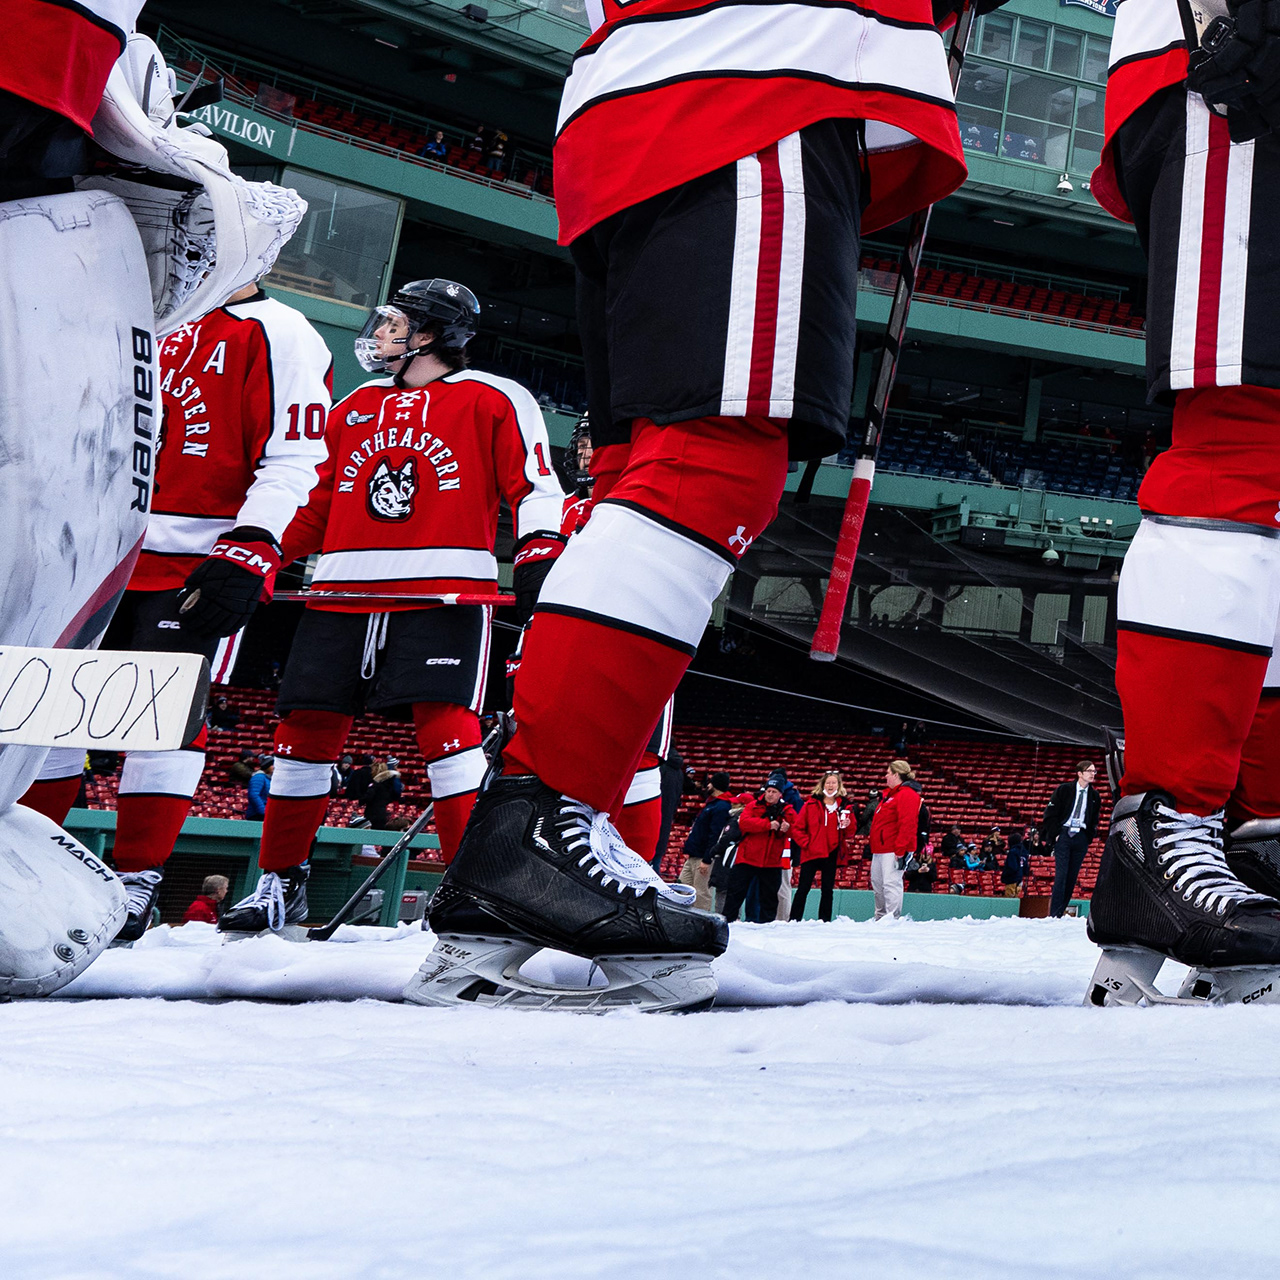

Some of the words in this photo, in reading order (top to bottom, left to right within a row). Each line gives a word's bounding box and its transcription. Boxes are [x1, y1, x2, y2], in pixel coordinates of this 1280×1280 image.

[187, 103, 276, 149] AVILION
[202, 340, 227, 375] A
[400, 348, 421, 360] CCM
[131, 326, 153, 515] BAUER
[285, 402, 326, 441] 10
[338, 427, 461, 493] NORTHEASTERN
[208, 543, 273, 575] CCM
[425, 657, 461, 667] CCM
[53, 658, 181, 742] SOX
[50, 834, 114, 884] MACH
[1241, 982, 1273, 1005] CCM
